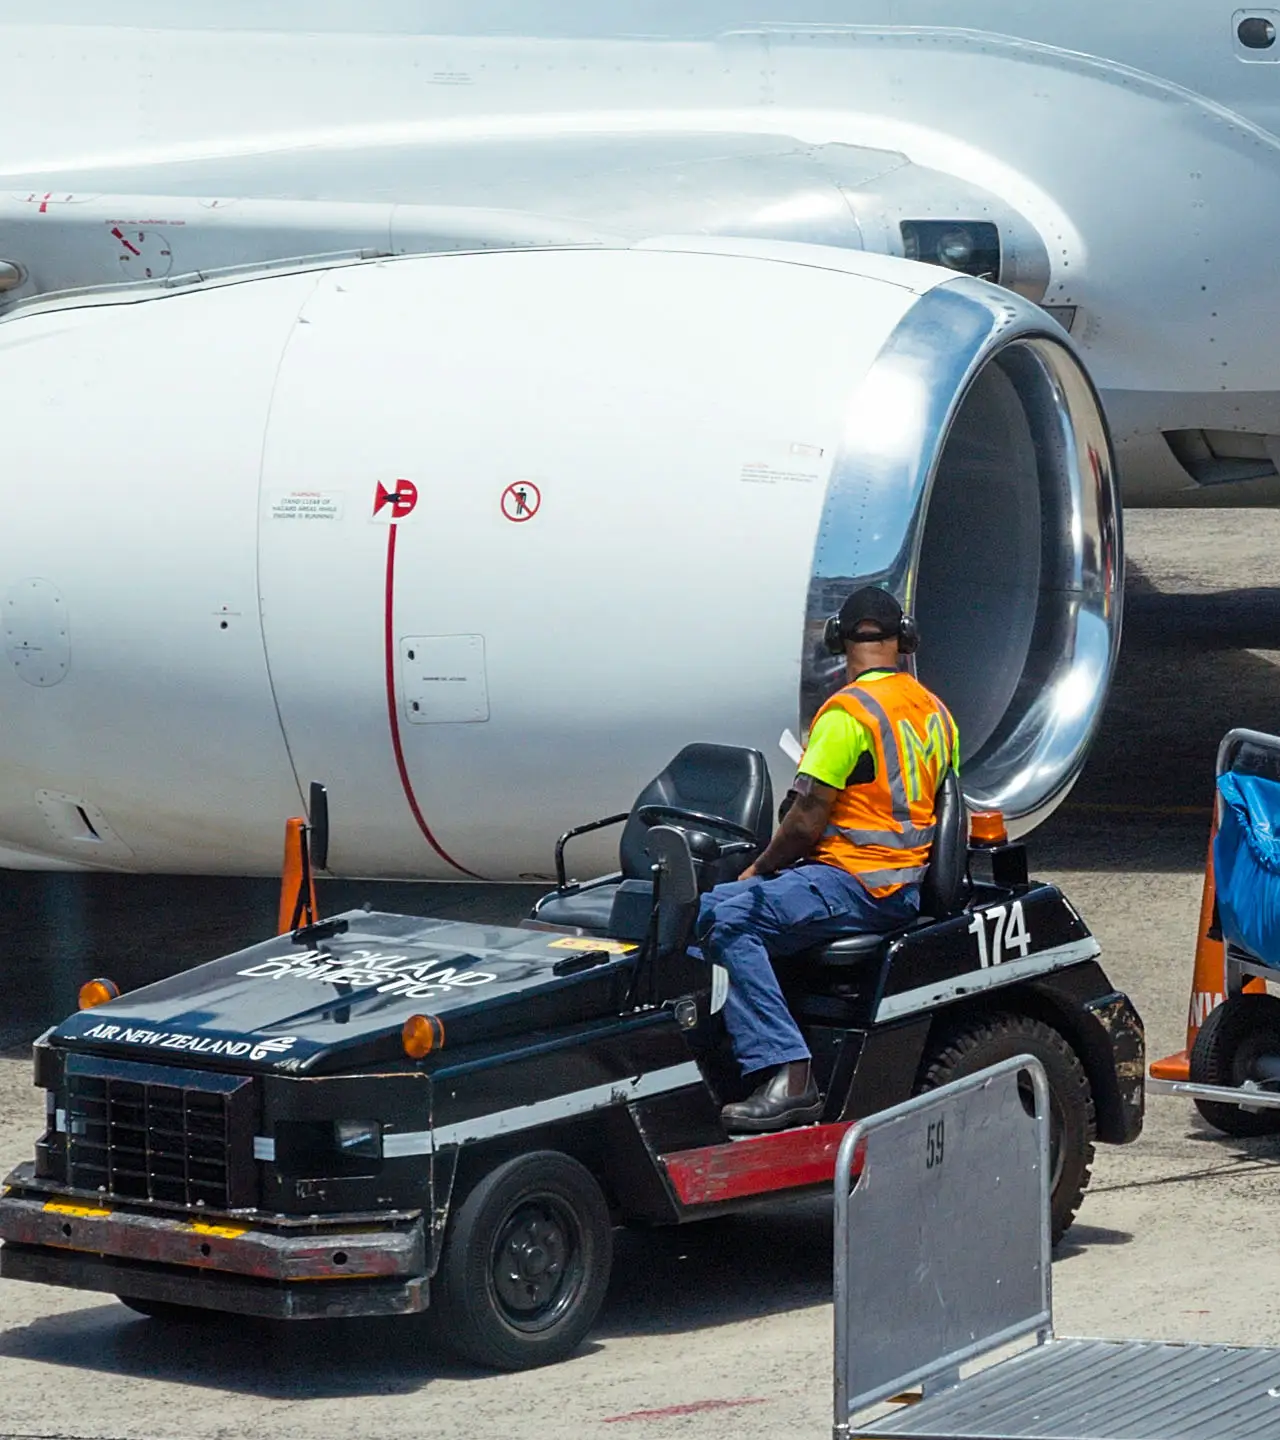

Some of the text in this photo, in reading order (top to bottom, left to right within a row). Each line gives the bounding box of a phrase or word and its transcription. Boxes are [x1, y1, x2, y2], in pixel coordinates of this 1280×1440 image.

[969, 900, 1031, 969] 174
[236, 962, 452, 999] DOMESTIC
[266, 949, 498, 987] AUCKLAND
[84, 1023, 251, 1057] AIR NEW ZEALAND
[926, 1119, 945, 1169] 59
